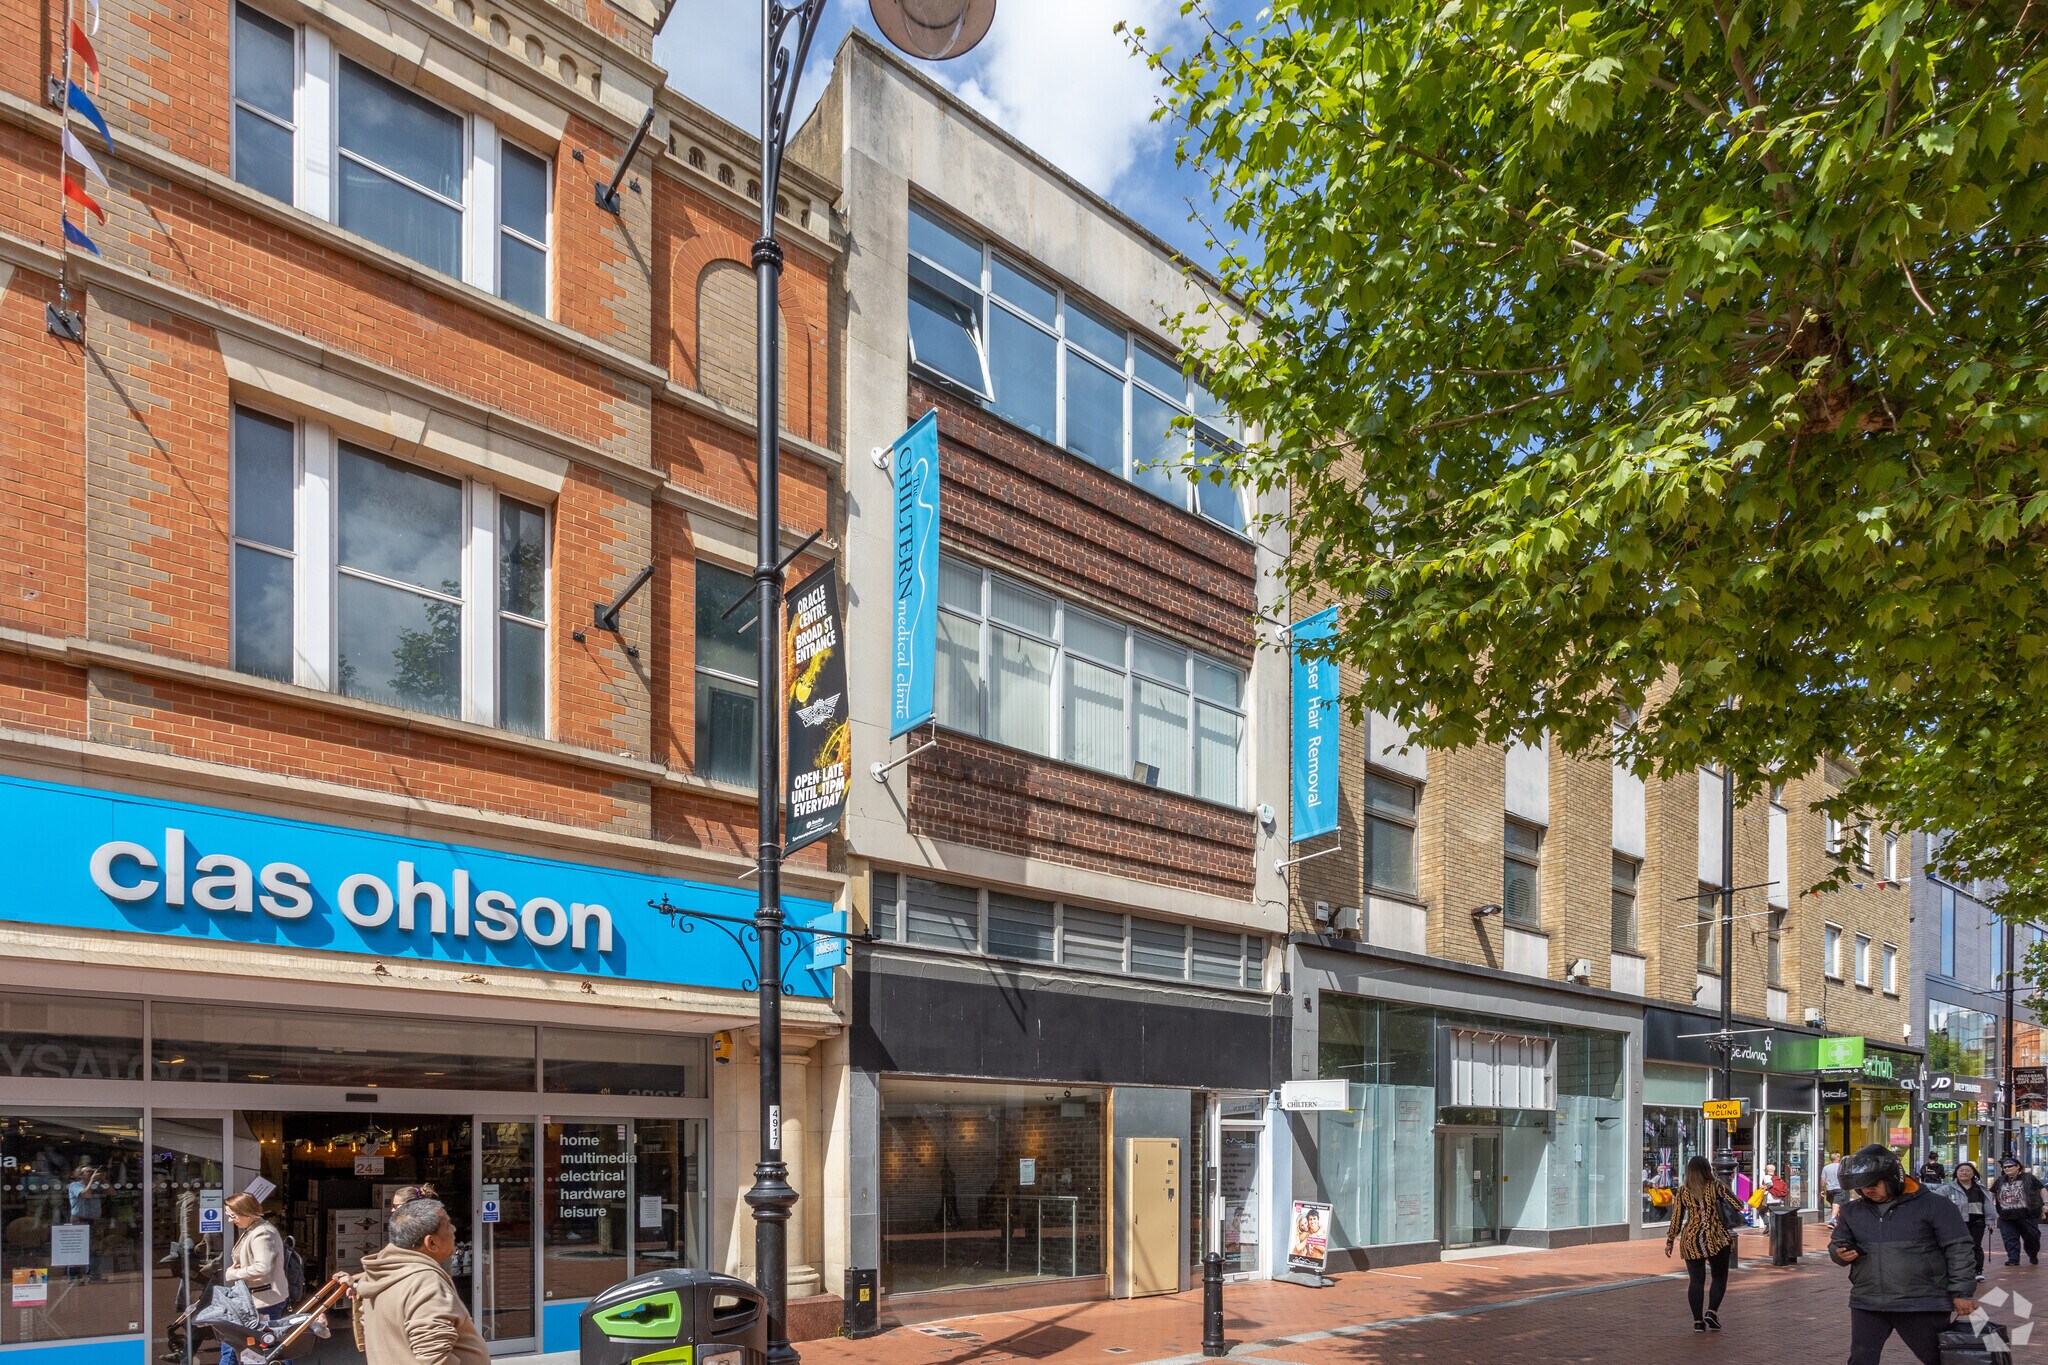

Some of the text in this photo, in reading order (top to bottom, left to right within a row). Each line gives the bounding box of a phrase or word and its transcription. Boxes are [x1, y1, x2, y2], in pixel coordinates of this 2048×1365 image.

[911, 473, 920, 498] The
[896, 446, 913, 719] CHILTERN medical clinic
[797, 584, 826, 615] ORACLE
[799, 599, 827, 630] CENTRE
[795, 615, 833, 650] BROAD ST
[795, 630, 837, 665] ENTRANCE
[1307, 657, 1323, 808] aser Hair Removal
[794, 762, 844, 790] OPEN LATE
[791, 776, 845, 805] UNTIL 11PM
[793, 791, 842, 818] EVERYDAY
[89, 827, 613, 952] clas ohlson
[1863, 1055, 1893, 1078] schuh
[1821, 1088, 1848, 1098] kids
[1931, 1077, 1951, 1089] JD
[1927, 1101, 1957, 1109] schuh
[559, 1134, 600, 1146] home
[560, 1152, 638, 1164] multimedia
[560, 1170, 624, 1182] electrical
[560, 1187, 626, 1200] hardware
[560, 1205, 607, 1218] leisure
